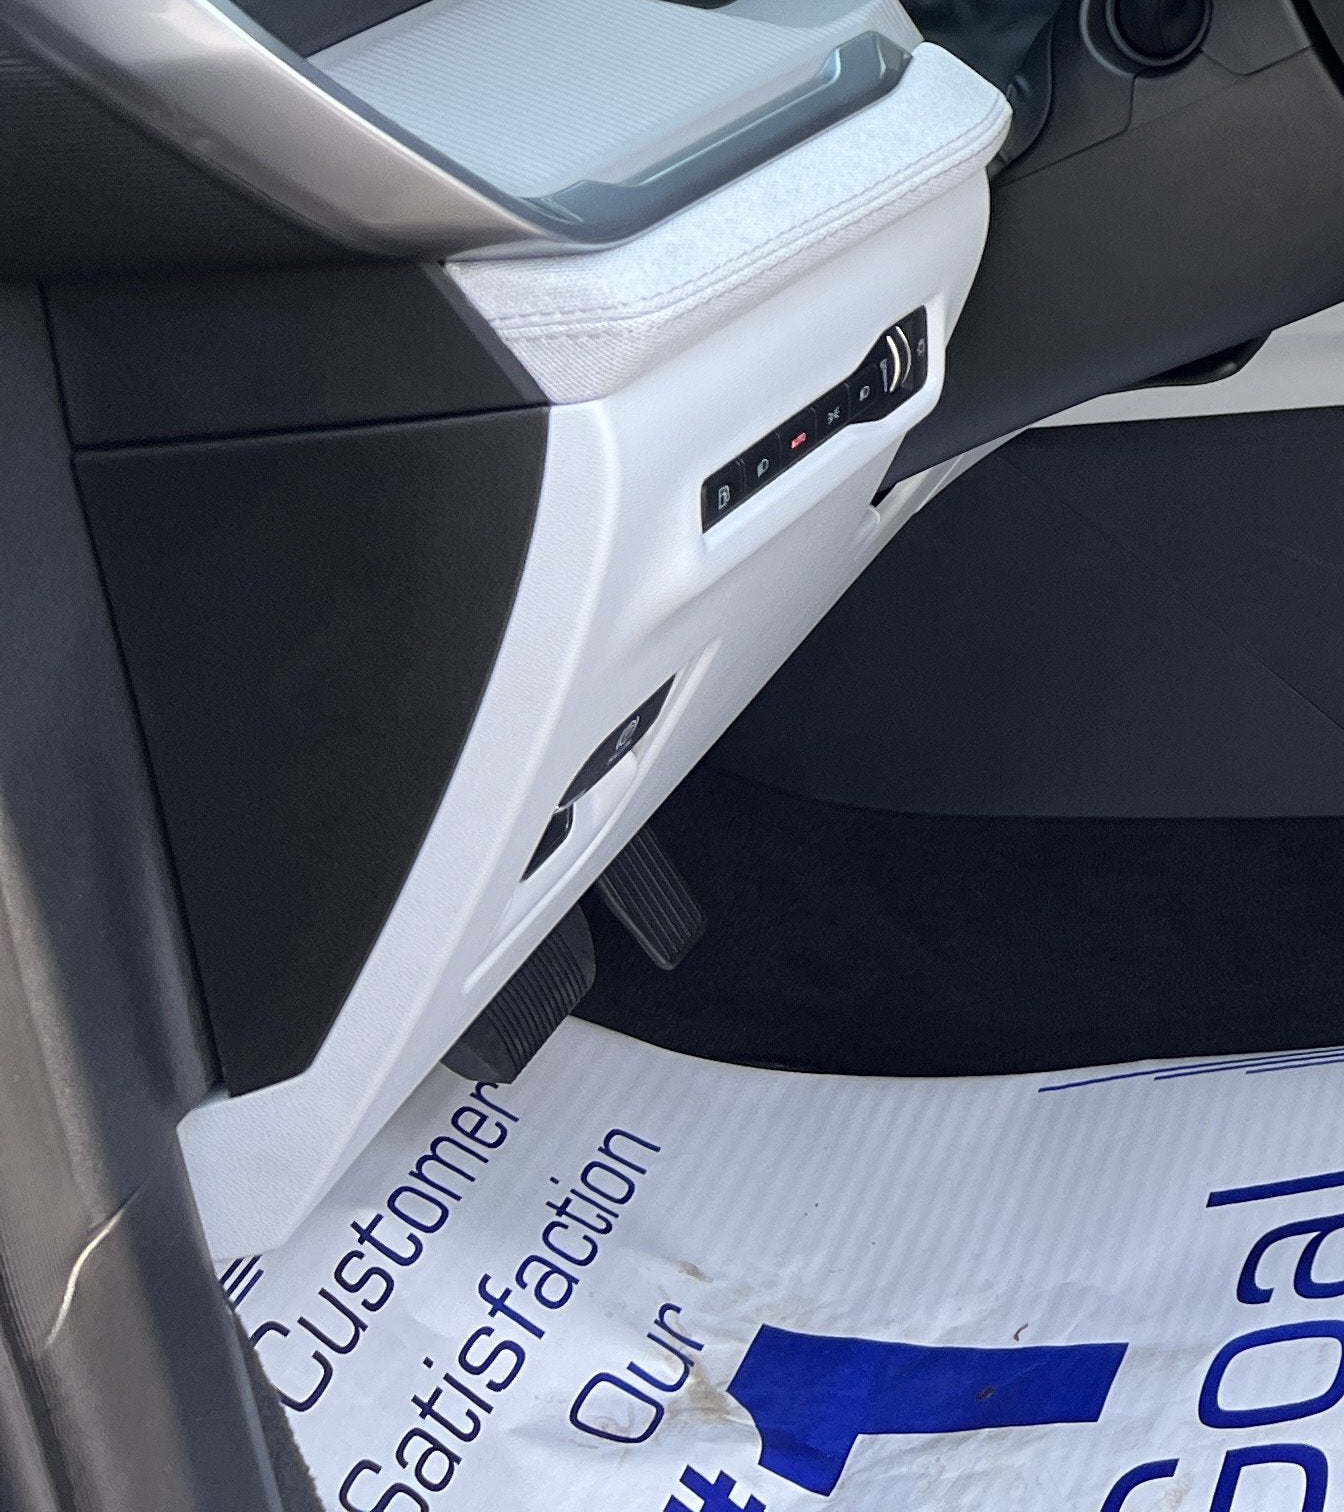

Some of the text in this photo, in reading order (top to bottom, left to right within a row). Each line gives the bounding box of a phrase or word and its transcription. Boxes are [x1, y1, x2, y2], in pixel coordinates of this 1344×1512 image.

[250, 1081, 521, 1413] Customer
[339, 1126, 662, 1512] Satisfaction
[568, 1303, 704, 1445] Our
